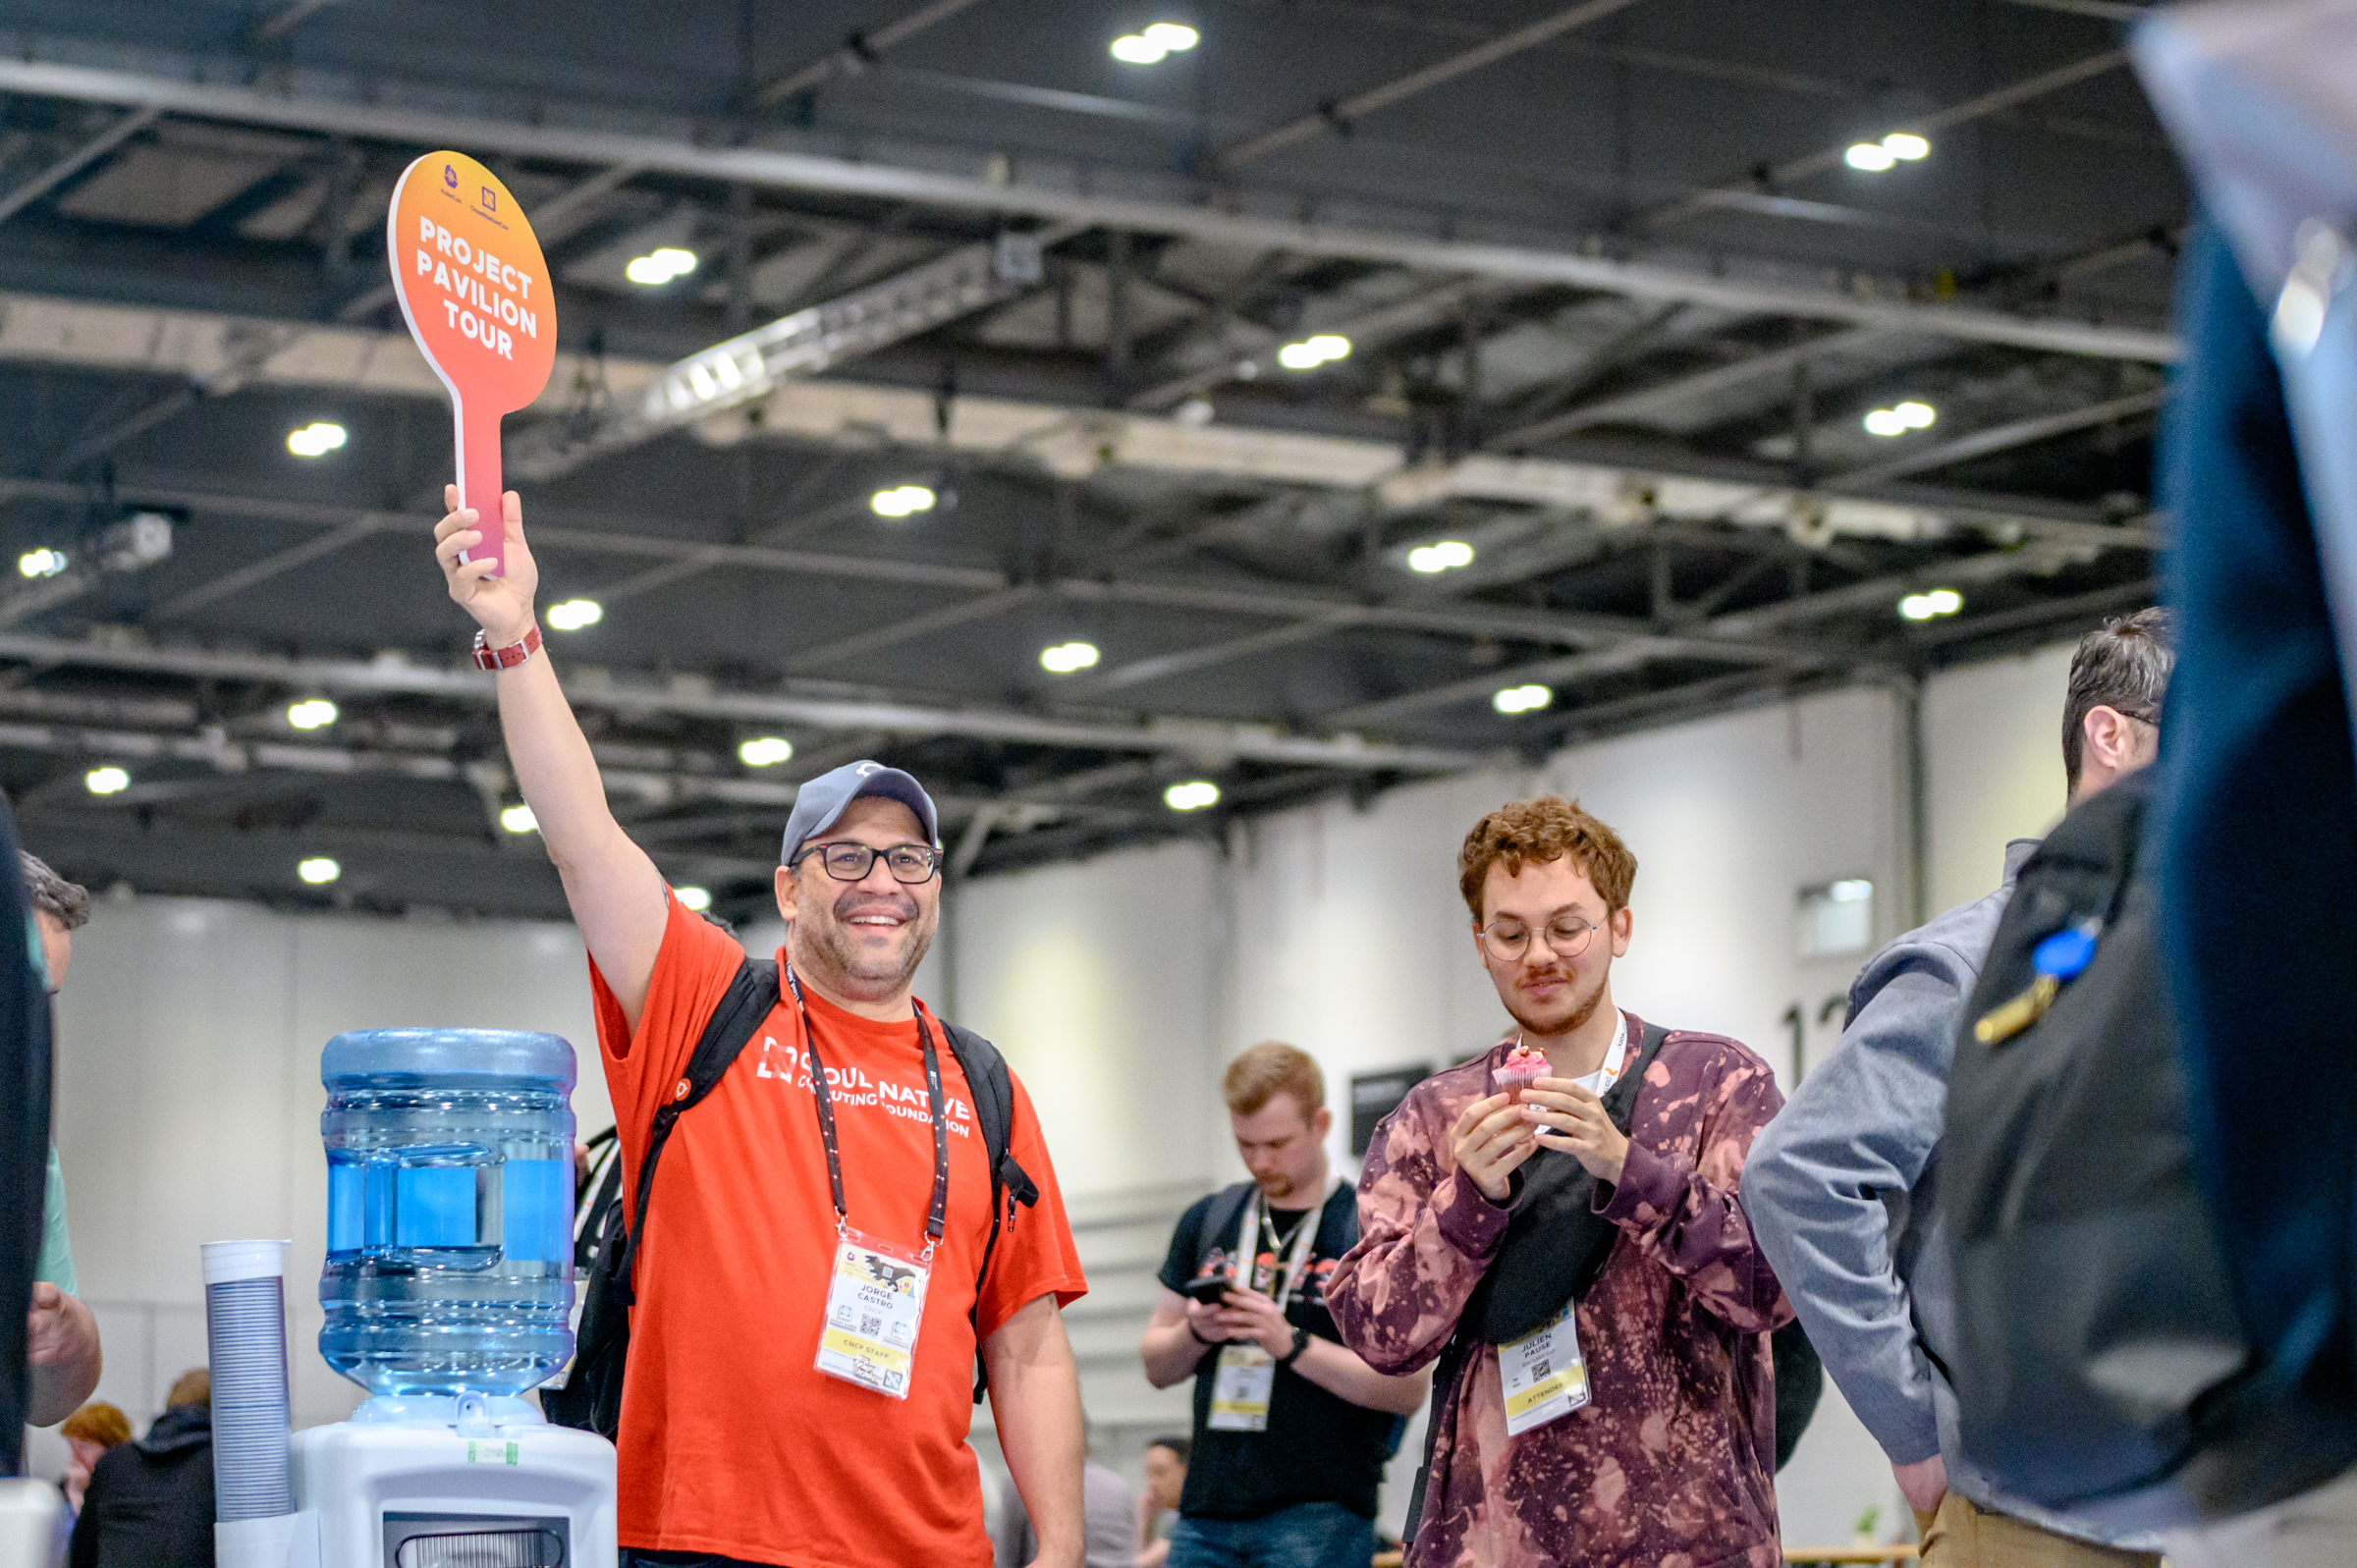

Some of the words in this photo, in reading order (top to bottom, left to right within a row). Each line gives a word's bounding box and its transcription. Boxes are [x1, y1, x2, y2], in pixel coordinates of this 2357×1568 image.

[420, 215, 532, 299] PROJECT
[416, 248, 537, 339] PAVILION
[444, 298, 513, 360] TOUR
[879, 1080, 970, 1120] NATVE
[881, 1100, 969, 1138] OUNDAION
[857, 1292, 893, 1309] CASTRO
[861, 1284, 893, 1300] JORGE
[843, 1338, 864, 1350] CNCF
[865, 1346, 889, 1358] STAFF
[1521, 1332, 1552, 1353] JULIEN
[1524, 1341, 1551, 1358] PAUSE
[1527, 1382, 1563, 1404] ATTENDEE
